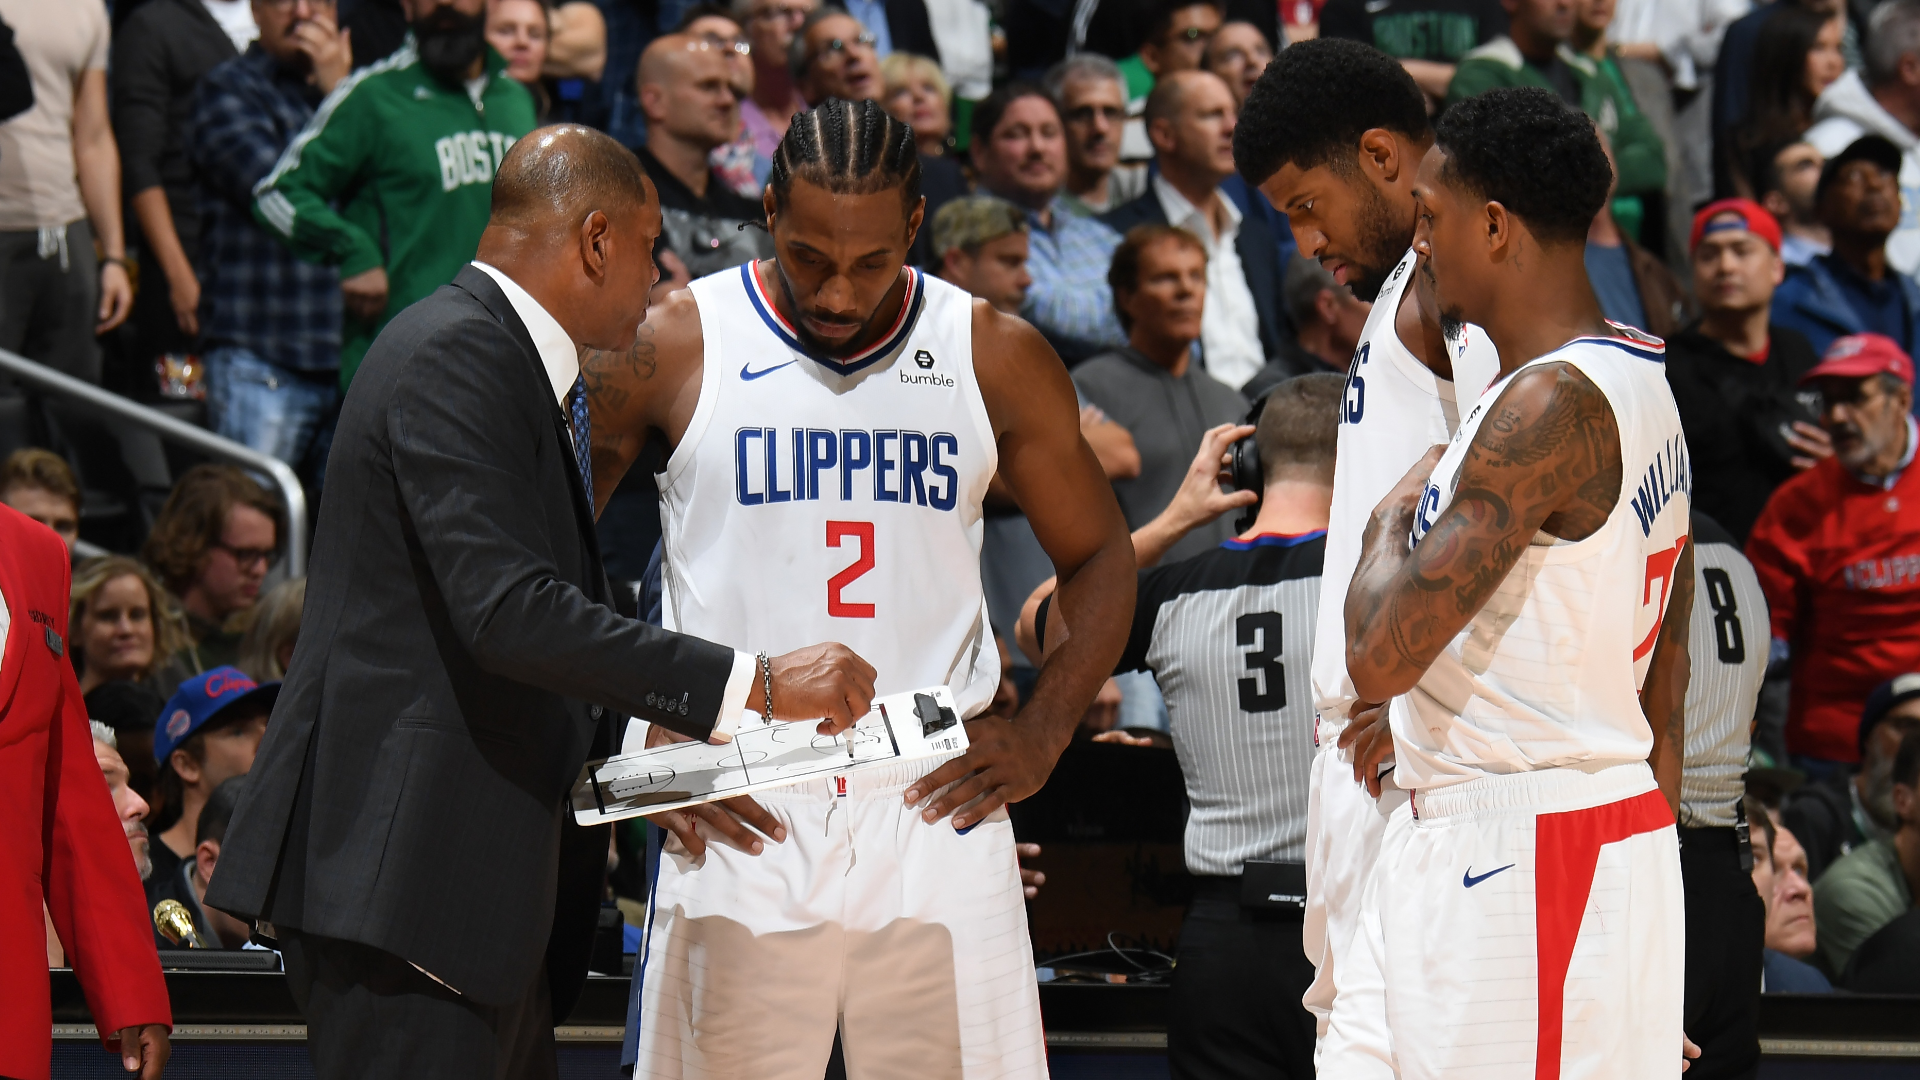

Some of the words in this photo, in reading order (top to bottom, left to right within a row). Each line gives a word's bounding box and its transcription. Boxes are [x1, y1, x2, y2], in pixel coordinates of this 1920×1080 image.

[899, 369, 954, 387] bumble
[734, 427, 959, 511] CLIPPERS
[826, 520, 876, 618] 2
[1703, 567, 1745, 664] 8
[1236, 611, 1287, 713] 3
